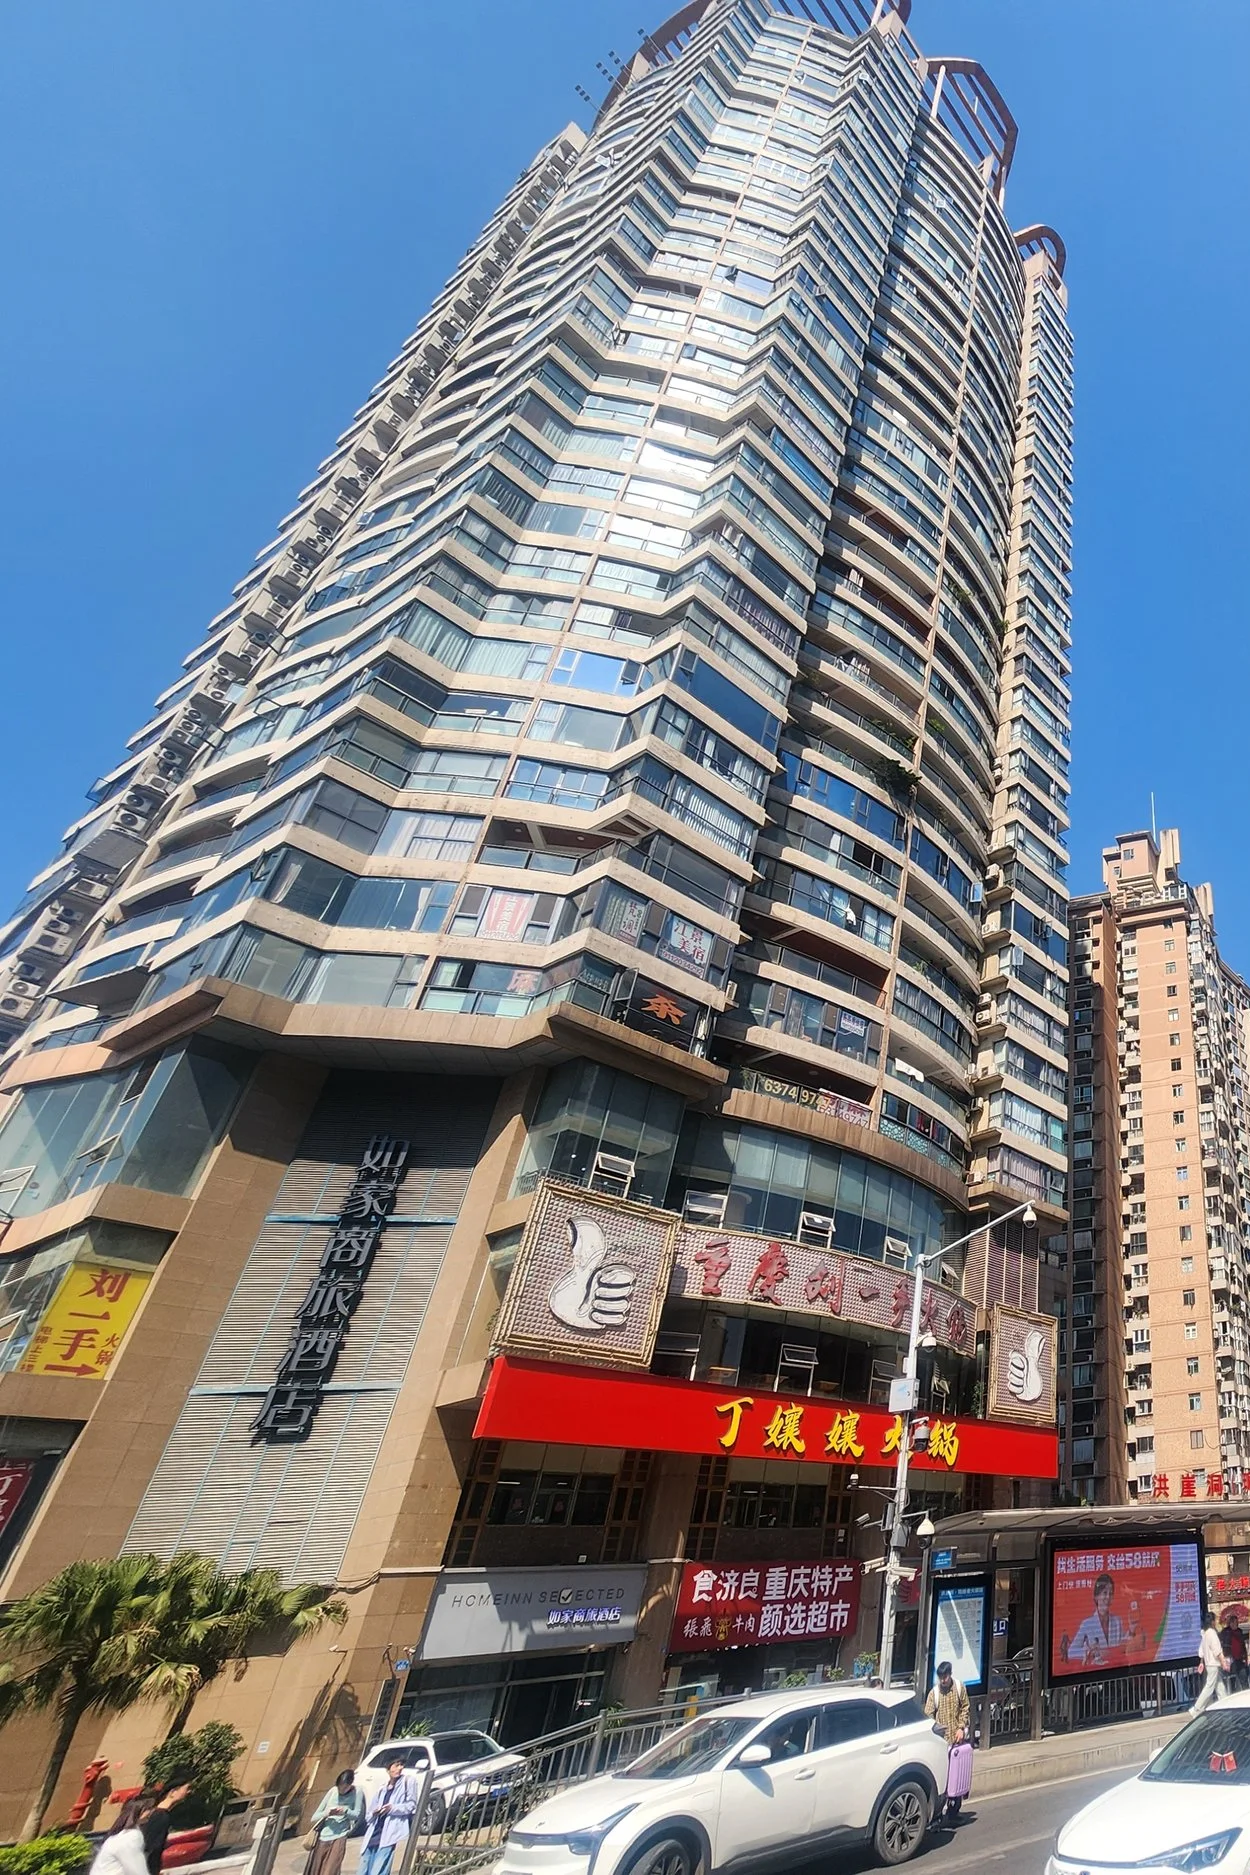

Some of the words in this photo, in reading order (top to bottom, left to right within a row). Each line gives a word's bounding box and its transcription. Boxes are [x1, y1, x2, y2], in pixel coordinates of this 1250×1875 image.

[250, 1134, 410, 1440] 如家商旅酒店
[52, 1268, 132, 1360] 刘一手
[95, 1333, 120, 1365] 火锅
[451, 1592, 533, 1608] HOMEINN
[539, 1587, 625, 1604] SEECTED
[762, 1565, 853, 1601] 重庆特产
[547, 1606, 622, 1626] 如家商旅酒店
[732, 1615, 756, 1633] 牛肉
[757, 1599, 850, 1638] 颜选超市
